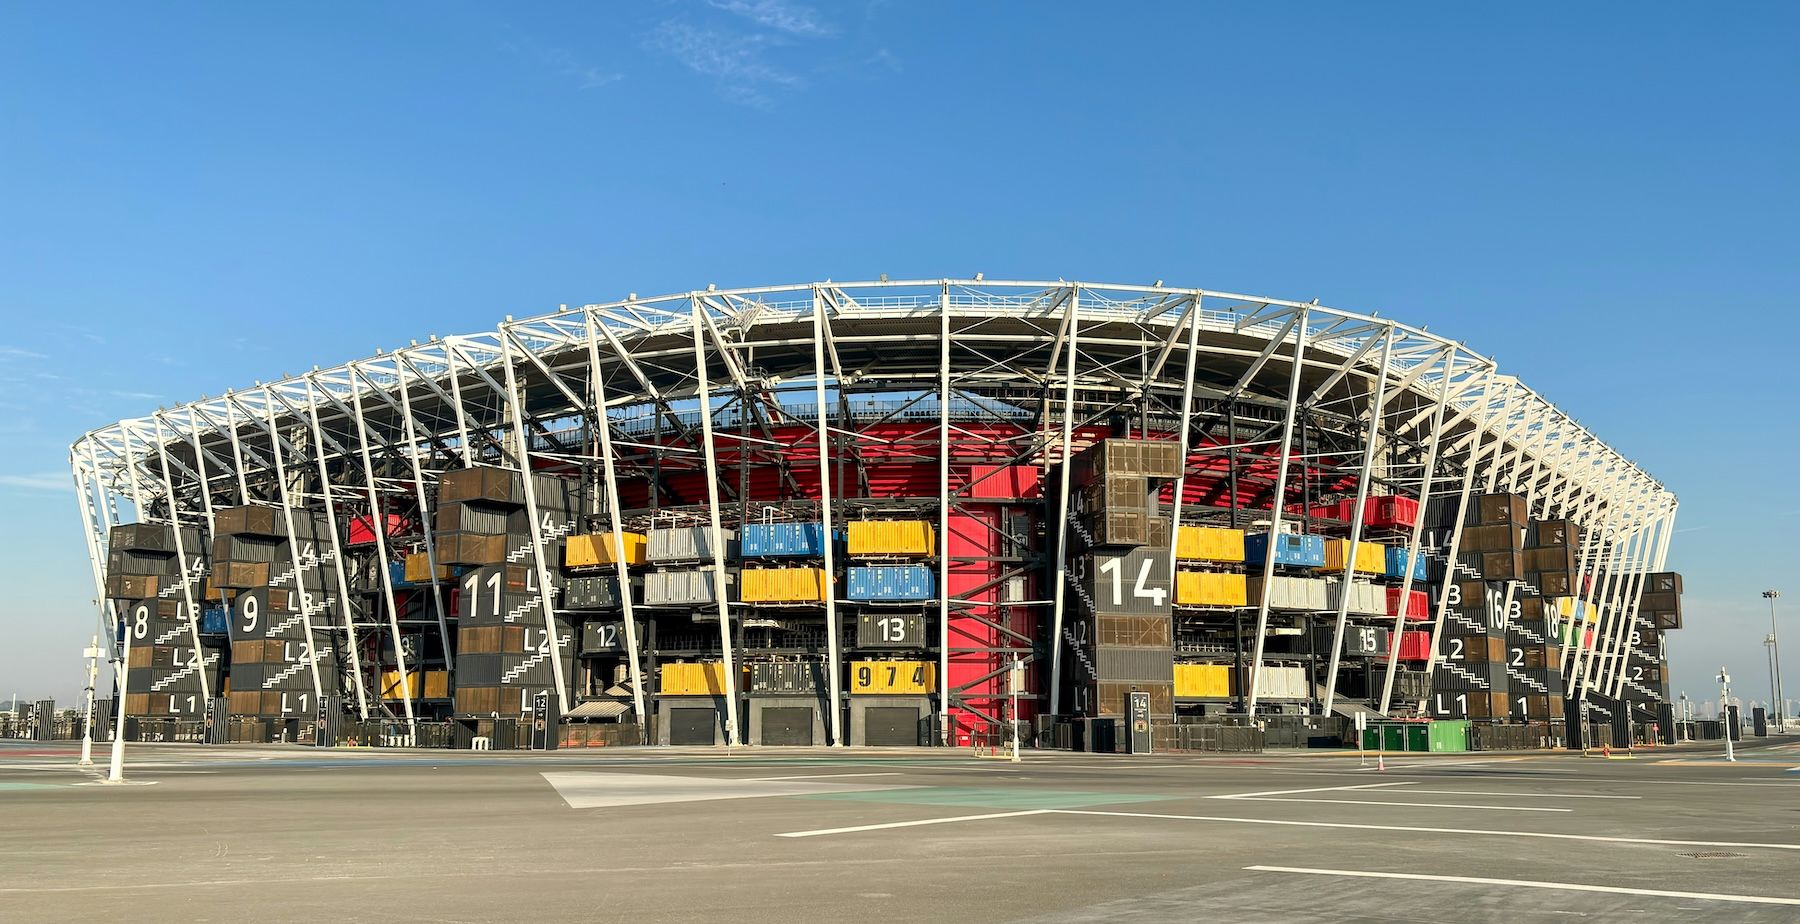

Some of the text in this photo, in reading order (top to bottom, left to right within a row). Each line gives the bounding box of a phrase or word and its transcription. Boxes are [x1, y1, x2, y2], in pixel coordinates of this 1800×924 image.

[1100, 557, 1167, 606] 14
[464, 572, 501, 617] 11
[242, 595, 258, 633] 9
[1486, 588, 1503, 629] 16
[134, 605, 149, 639] 8
[877, 618, 905, 641] 13
[1544, 603, 1559, 639] 18
[524, 628, 550, 653] L2
[597, 625, 617, 647] 12
[1360, 628, 1376, 652] 15
[173, 648, 198, 667] L2
[285, 642, 310, 662] L2
[169, 695, 196, 713] L1
[281, 693, 308, 712] L1
[536, 699, 546, 707] 12
[1134, 699, 1148, 708] 14
[1437, 694, 1467, 715] L1
